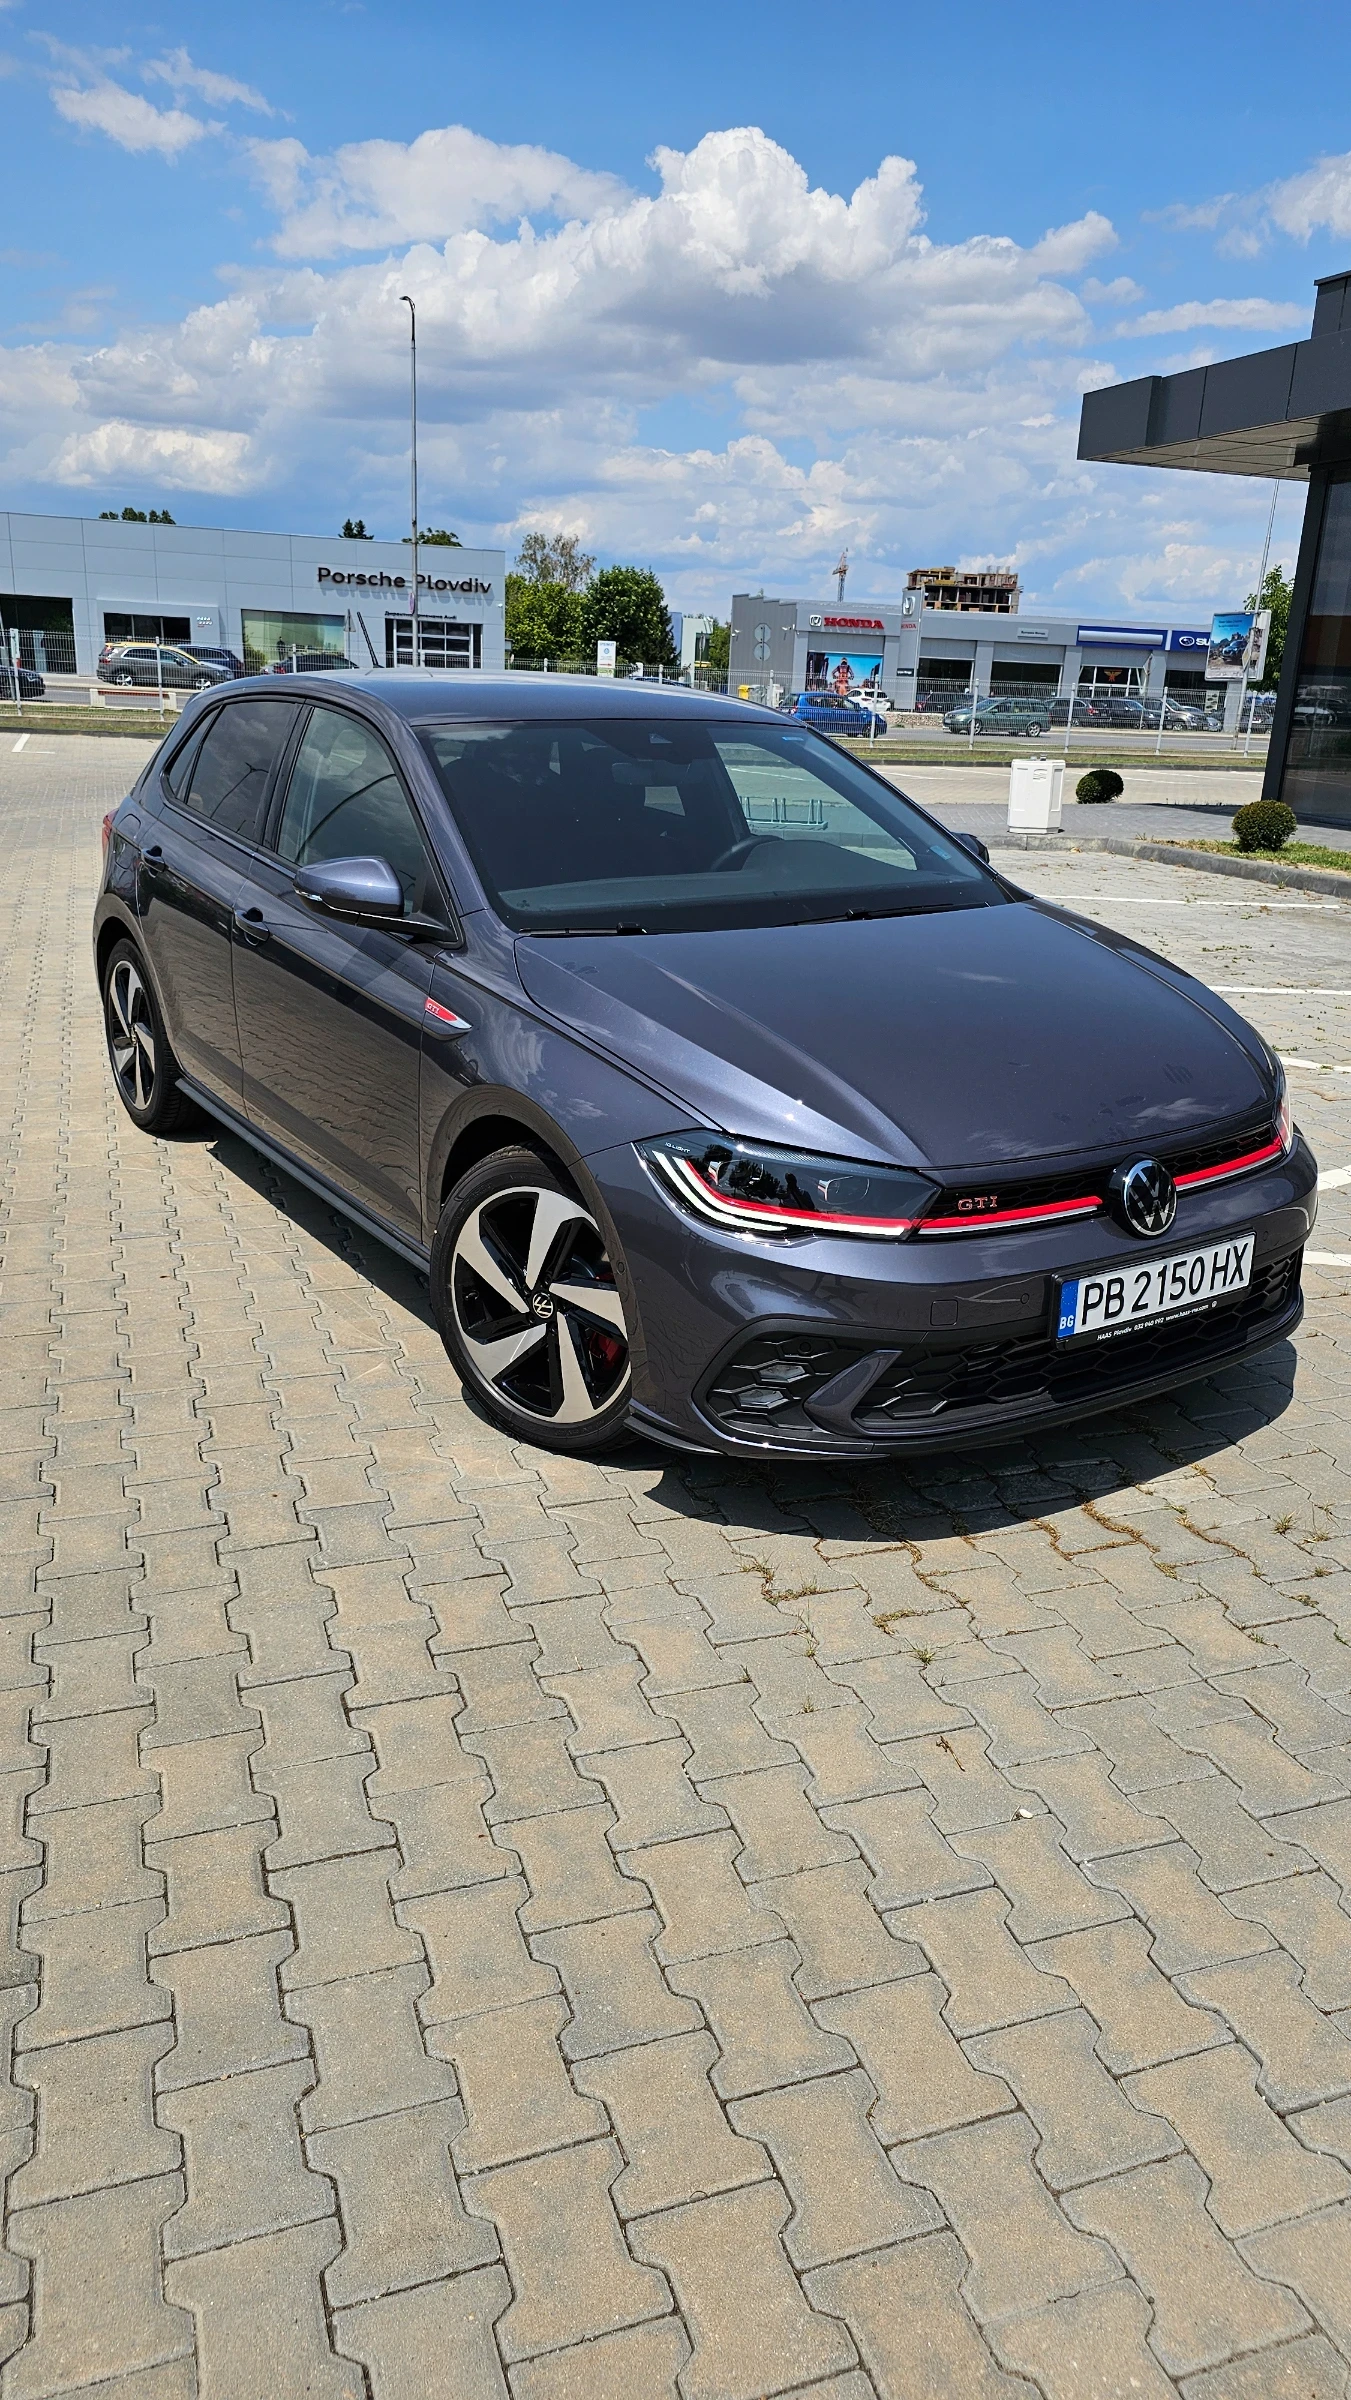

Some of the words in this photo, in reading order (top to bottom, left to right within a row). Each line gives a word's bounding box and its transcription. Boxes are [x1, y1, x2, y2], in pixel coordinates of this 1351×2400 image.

[318, 567, 406, 588] Porsche
[823, 617, 885, 629] HONDA
[427, 1003, 440, 1015] GTI
[957, 1195, 998, 1211] GTI
[1081, 1277, 1125, 1326] PB
[1131, 1256, 1205, 1313] 2150
[1209, 1242, 1249, 1291] HX
[1059, 1315, 1074, 1330] BG
[1097, 1331, 1112, 1341] HAAS
[1113, 1327, 1132, 1337] Plovdiv
